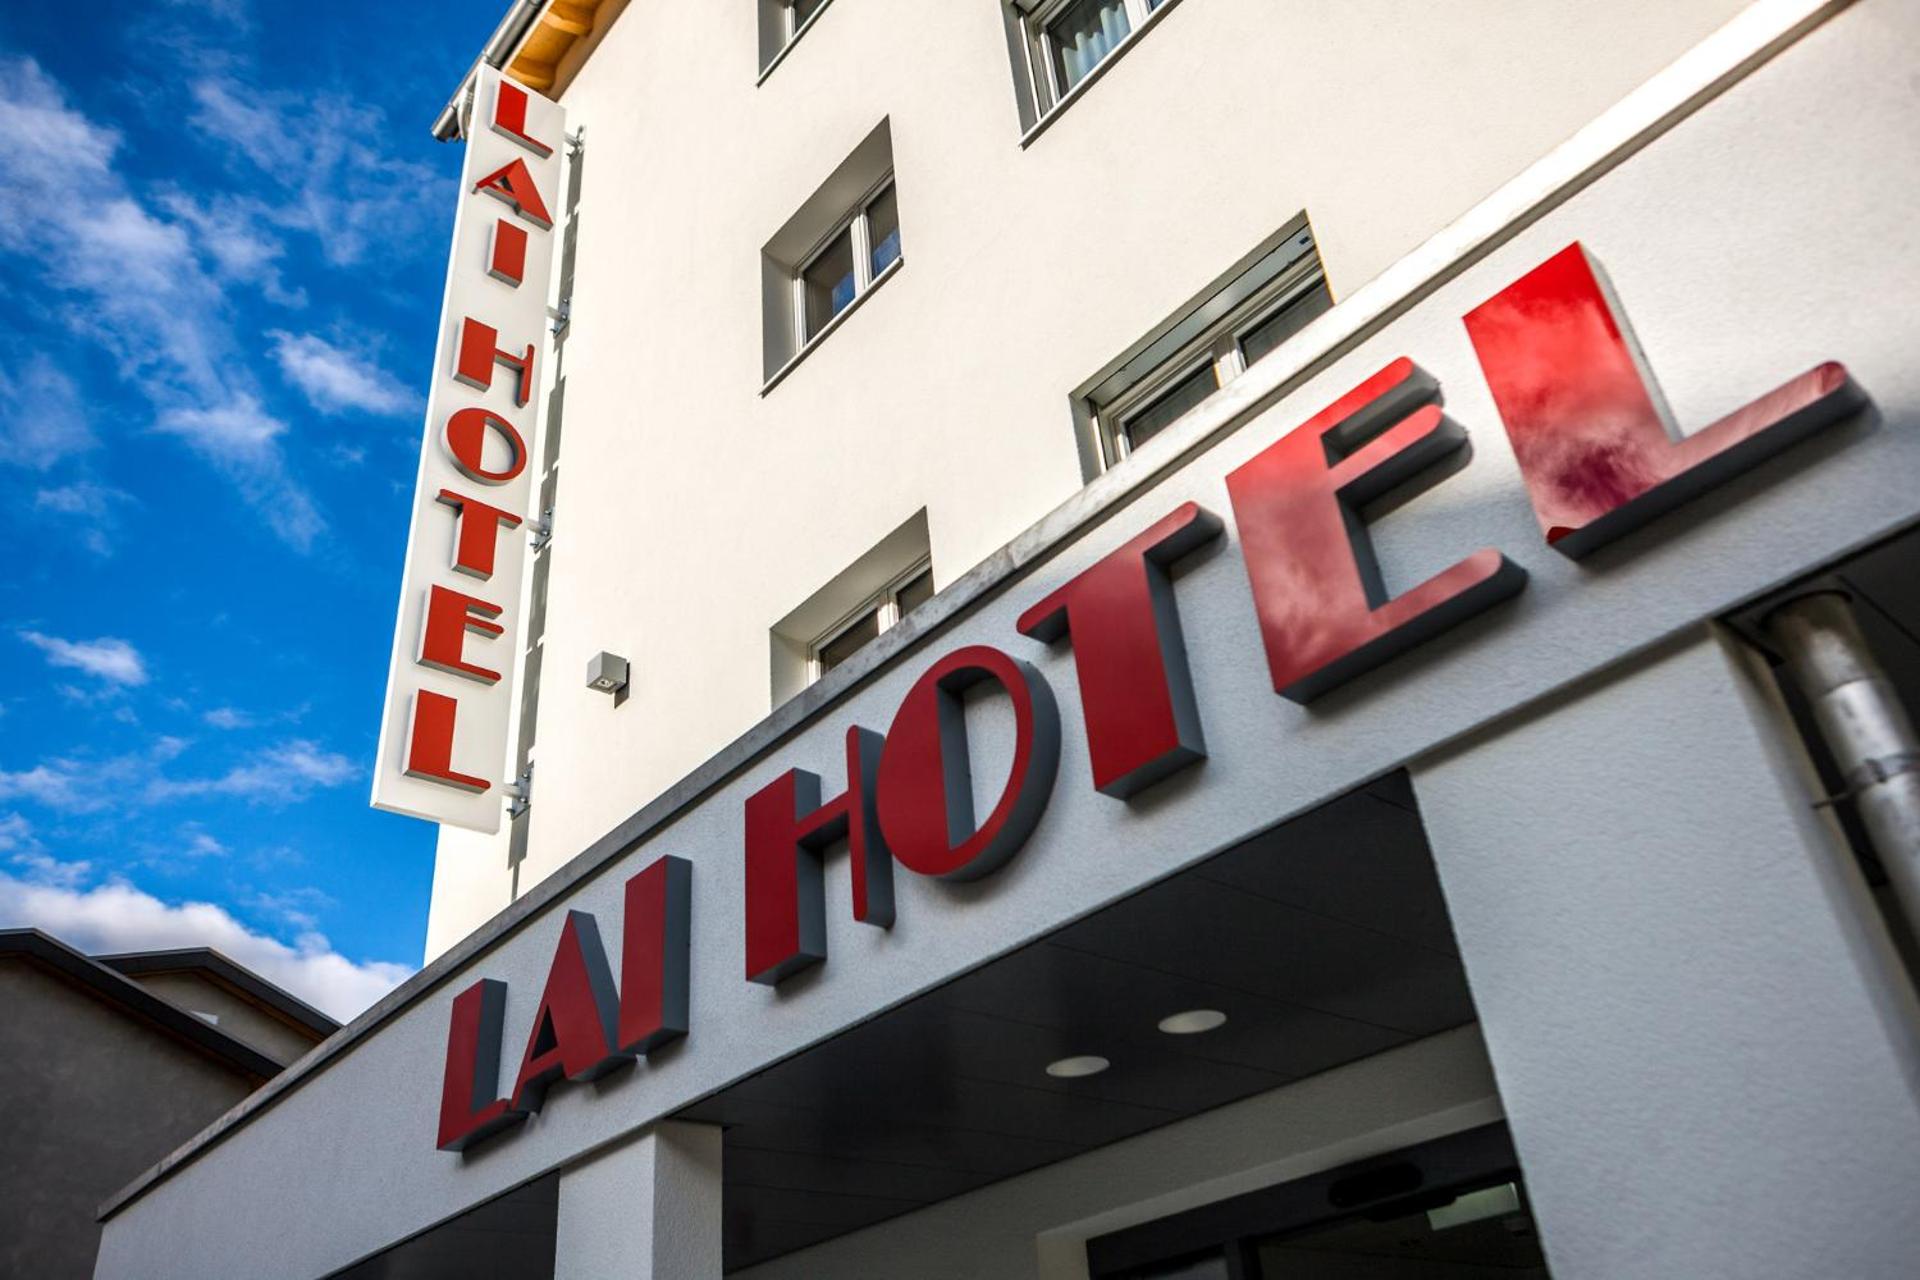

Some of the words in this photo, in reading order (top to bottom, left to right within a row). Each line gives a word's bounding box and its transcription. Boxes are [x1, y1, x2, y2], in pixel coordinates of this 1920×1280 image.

[474, 80, 554, 287] LAI
[405, 317, 536, 791] HOTEL
[438, 856, 690, 1151] LAI
[745, 241, 1866, 982] HOTEL
